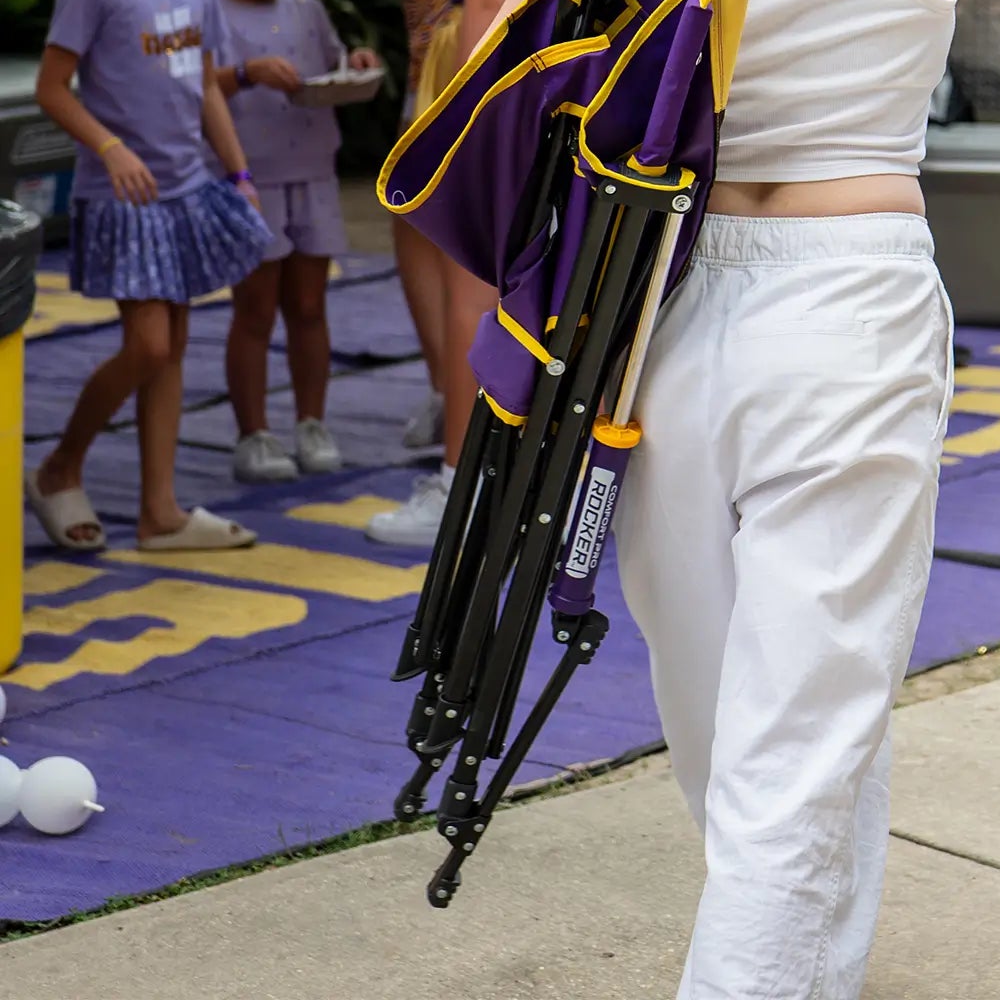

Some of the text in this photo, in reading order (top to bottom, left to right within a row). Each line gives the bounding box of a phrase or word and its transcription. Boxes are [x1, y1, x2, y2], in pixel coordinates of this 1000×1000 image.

[574, 480, 606, 566] ROCKER
[590, 484, 618, 569] COMFORT PRO
